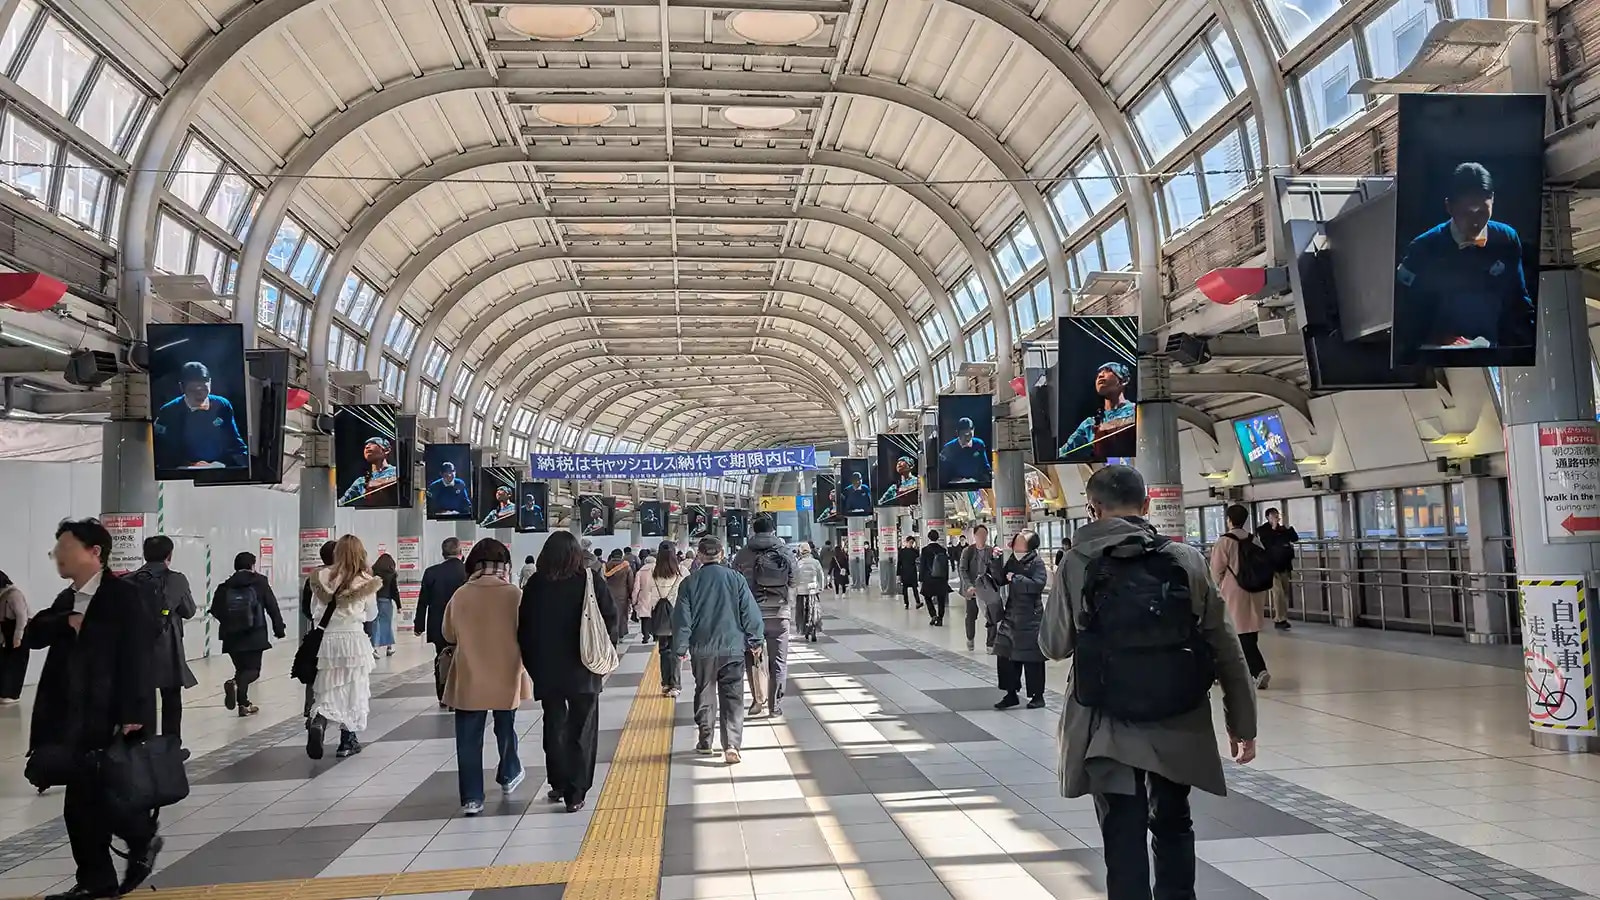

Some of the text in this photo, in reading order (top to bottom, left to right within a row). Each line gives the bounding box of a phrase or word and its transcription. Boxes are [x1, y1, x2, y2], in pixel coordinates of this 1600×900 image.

[1544, 493, 1568, 501] walk
[1570, 493, 1579, 501] in
[1581, 493, 1594, 501] the
[1528, 615, 1548, 660] 走行
[1551, 599, 1581, 673] 自転車
